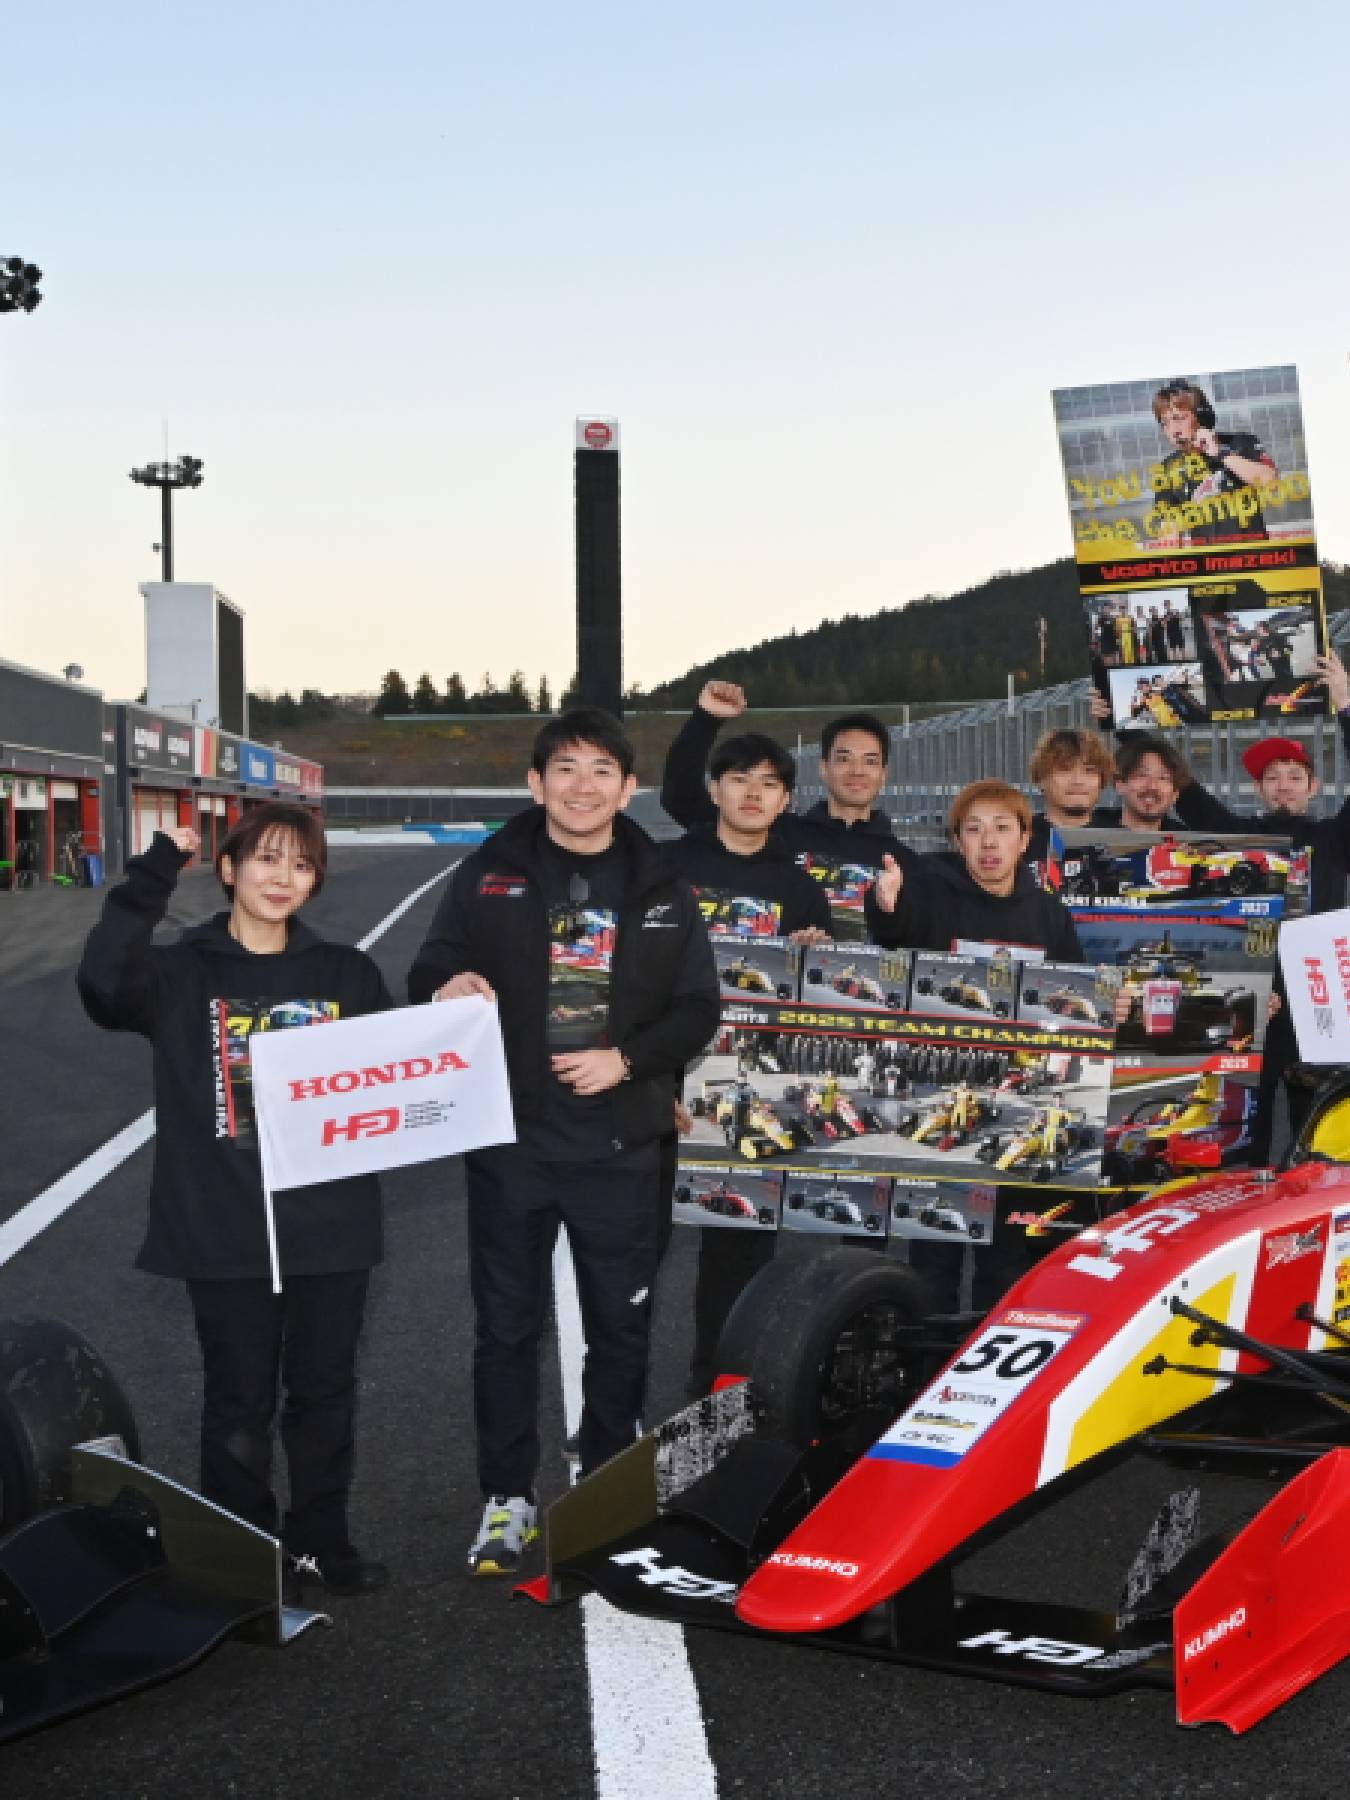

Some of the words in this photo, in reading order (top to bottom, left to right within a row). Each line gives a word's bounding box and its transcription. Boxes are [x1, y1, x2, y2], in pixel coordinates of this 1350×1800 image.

[778, 1011, 856, 1028] 2025
[864, 1018, 947, 1037] TEAM
[951, 1024, 1114, 1051] CHAMPION
[288, 1050, 471, 1101] HONDA
[952, 1334, 1057, 1379] 50
[767, 1551, 861, 1577] KUMHO
[1184, 1608, 1247, 1662] KUMHO
